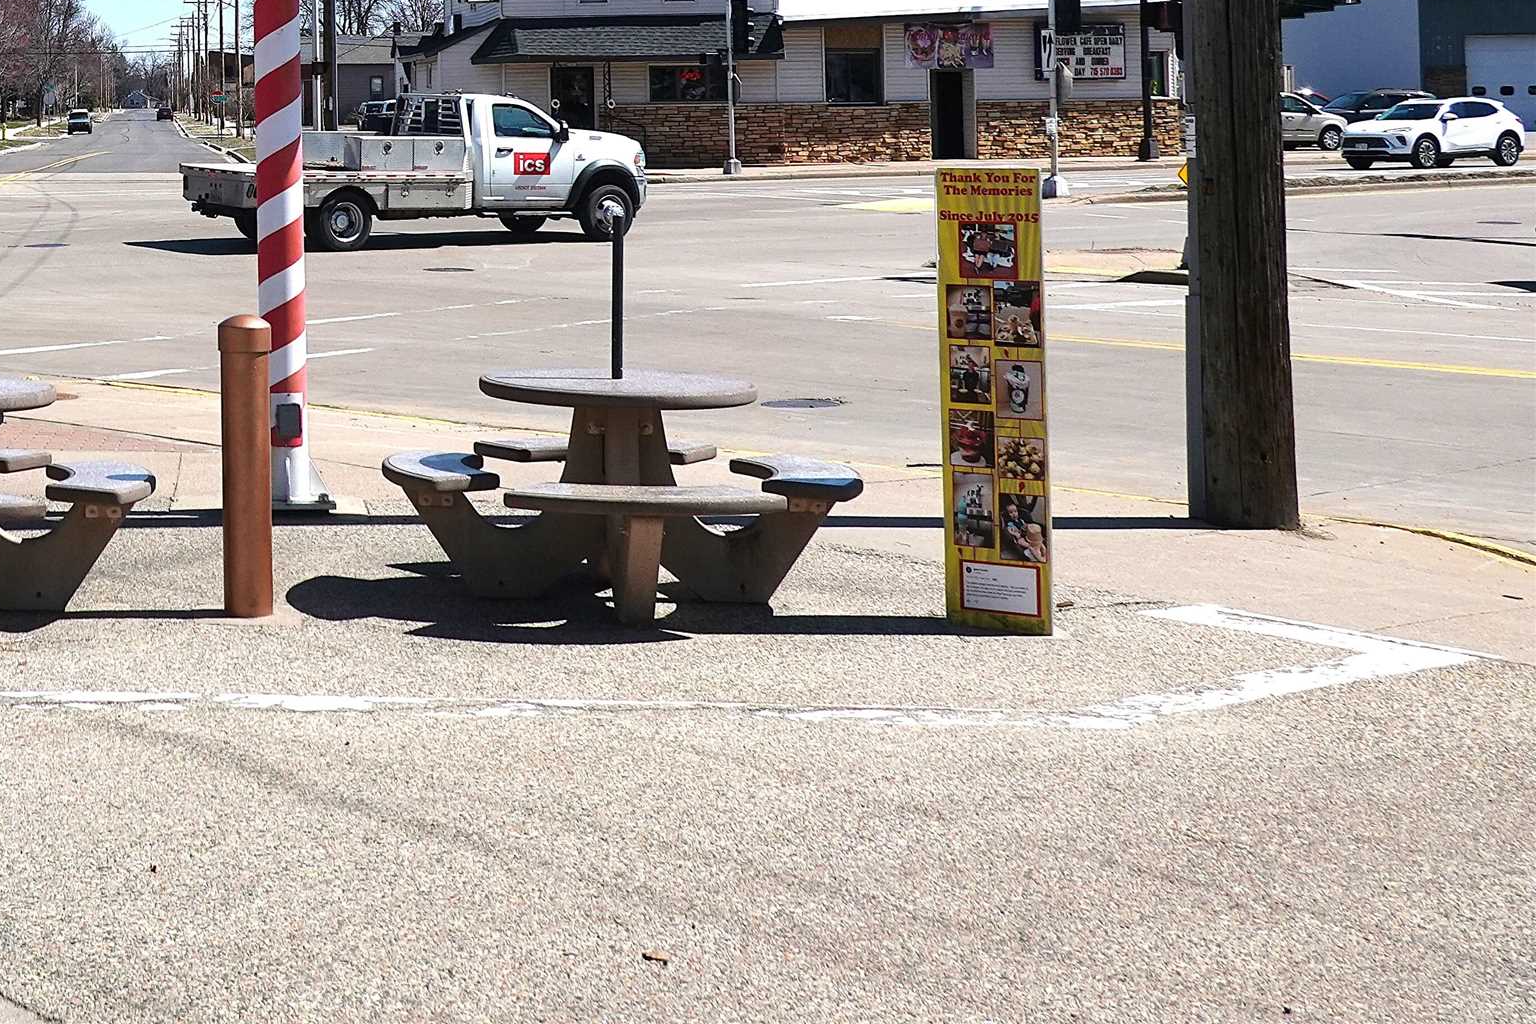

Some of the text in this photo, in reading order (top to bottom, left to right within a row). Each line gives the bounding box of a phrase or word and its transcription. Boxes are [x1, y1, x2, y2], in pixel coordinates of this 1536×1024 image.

[519, 154, 545, 172] ics
[940, 172, 1036, 184] Thank You For
[944, 185, 1033, 196] The Memories
[939, 210, 1040, 224] Since July 2015
